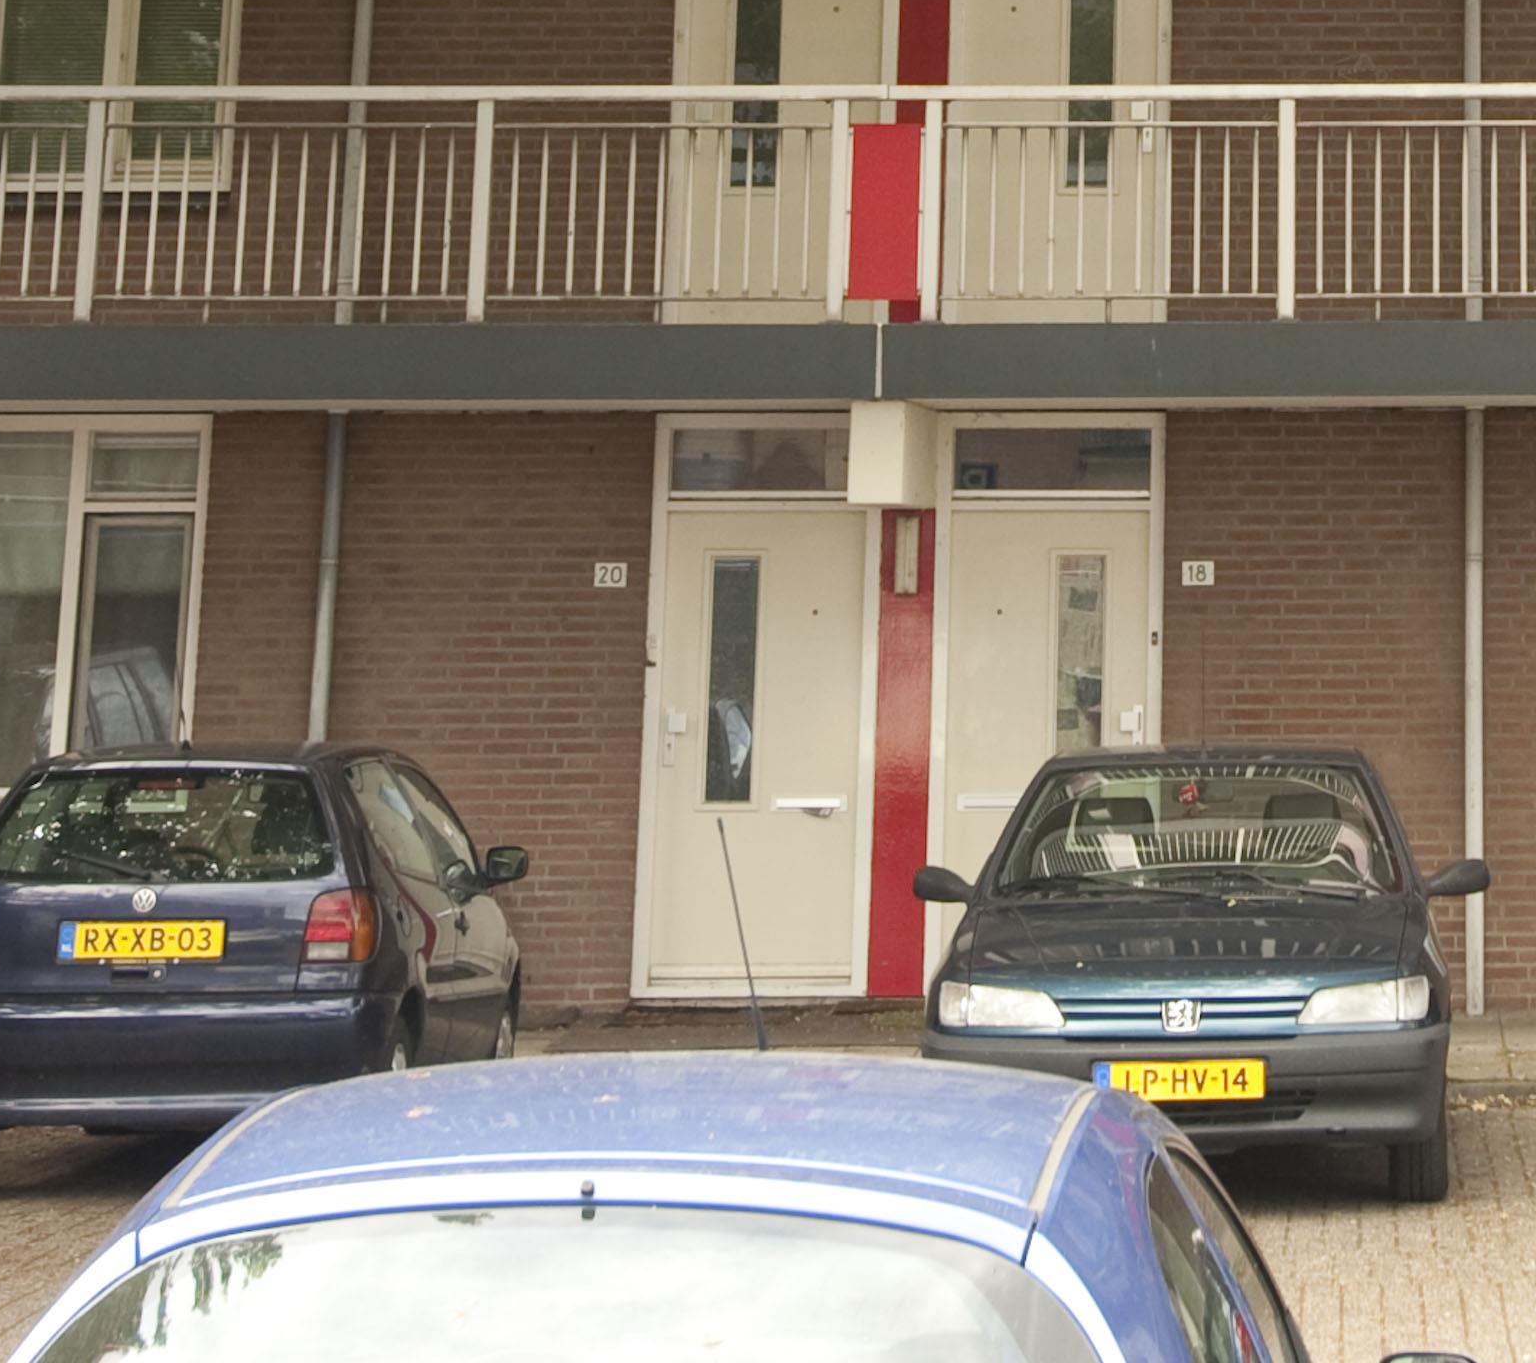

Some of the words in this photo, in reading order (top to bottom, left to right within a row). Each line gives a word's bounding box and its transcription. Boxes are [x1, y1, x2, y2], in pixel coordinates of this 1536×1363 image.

[598, 565, 623, 584] 20
[1187, 564, 1207, 582] 18
[83, 927, 212, 953] RX-XB-03
